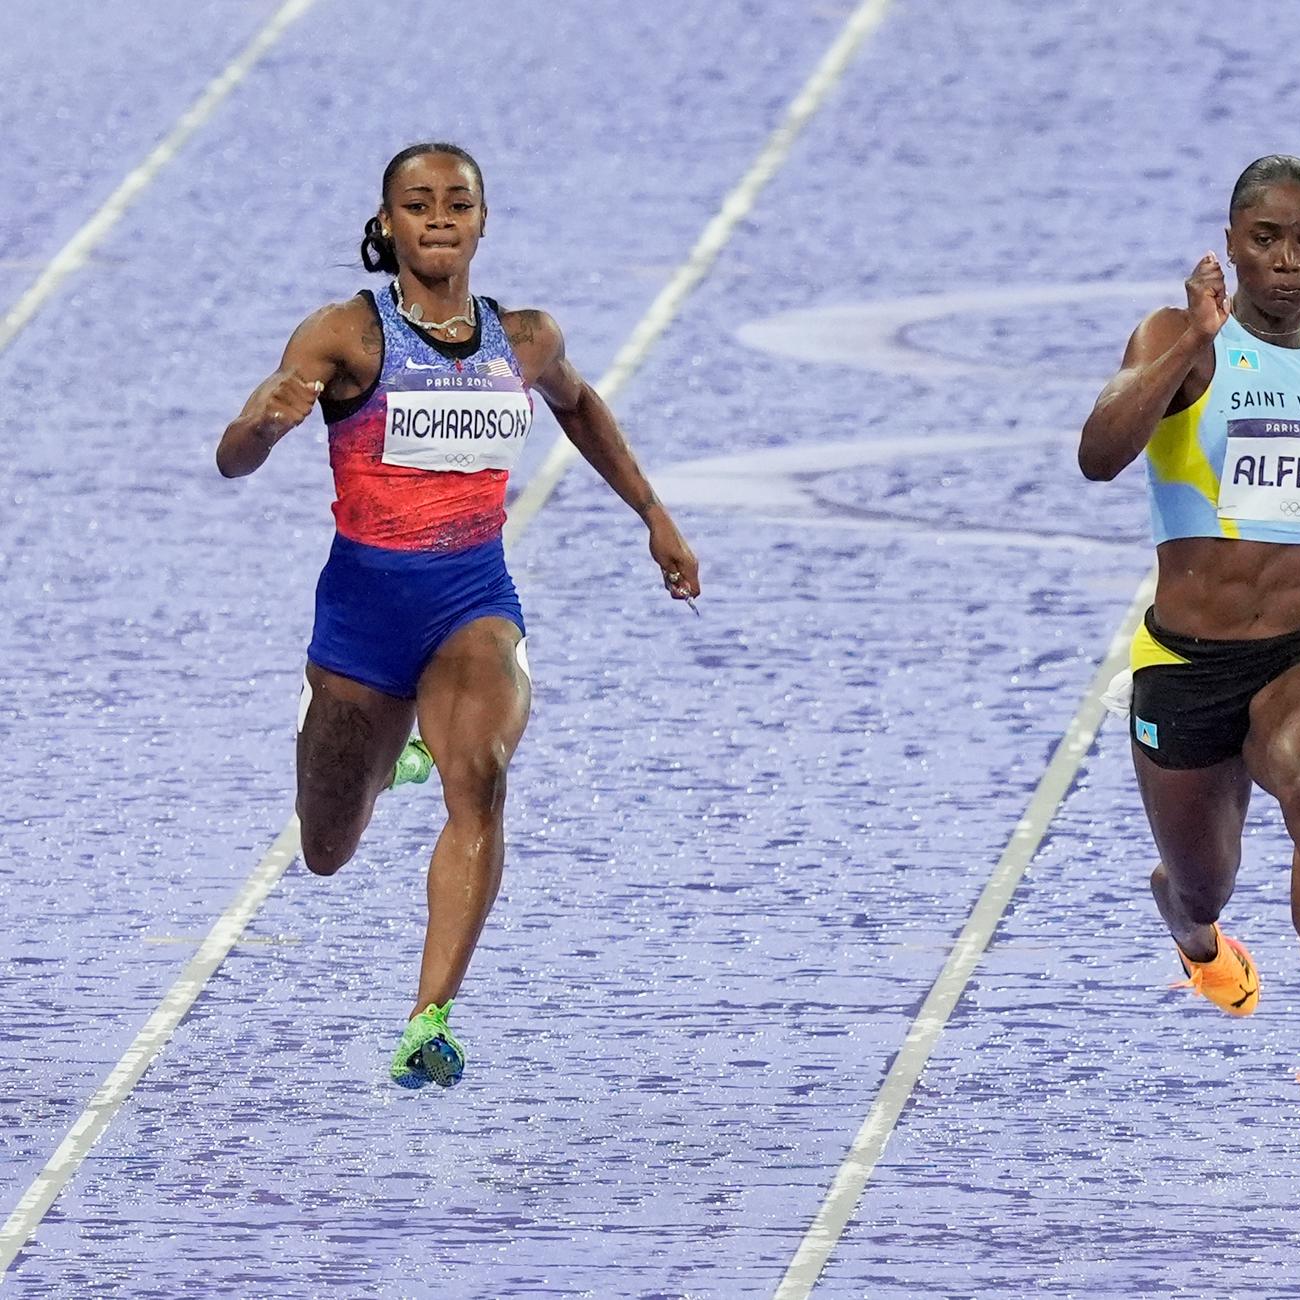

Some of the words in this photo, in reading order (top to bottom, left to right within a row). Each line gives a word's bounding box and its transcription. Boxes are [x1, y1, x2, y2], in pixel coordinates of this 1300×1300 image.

[426, 376, 463, 388] PARIS
[466, 377, 493, 388] 2024
[1231, 391, 1285, 410] SAINT
[391, 408, 527, 439] RICHARDSON
[1266, 424, 1300, 432] PARIS
